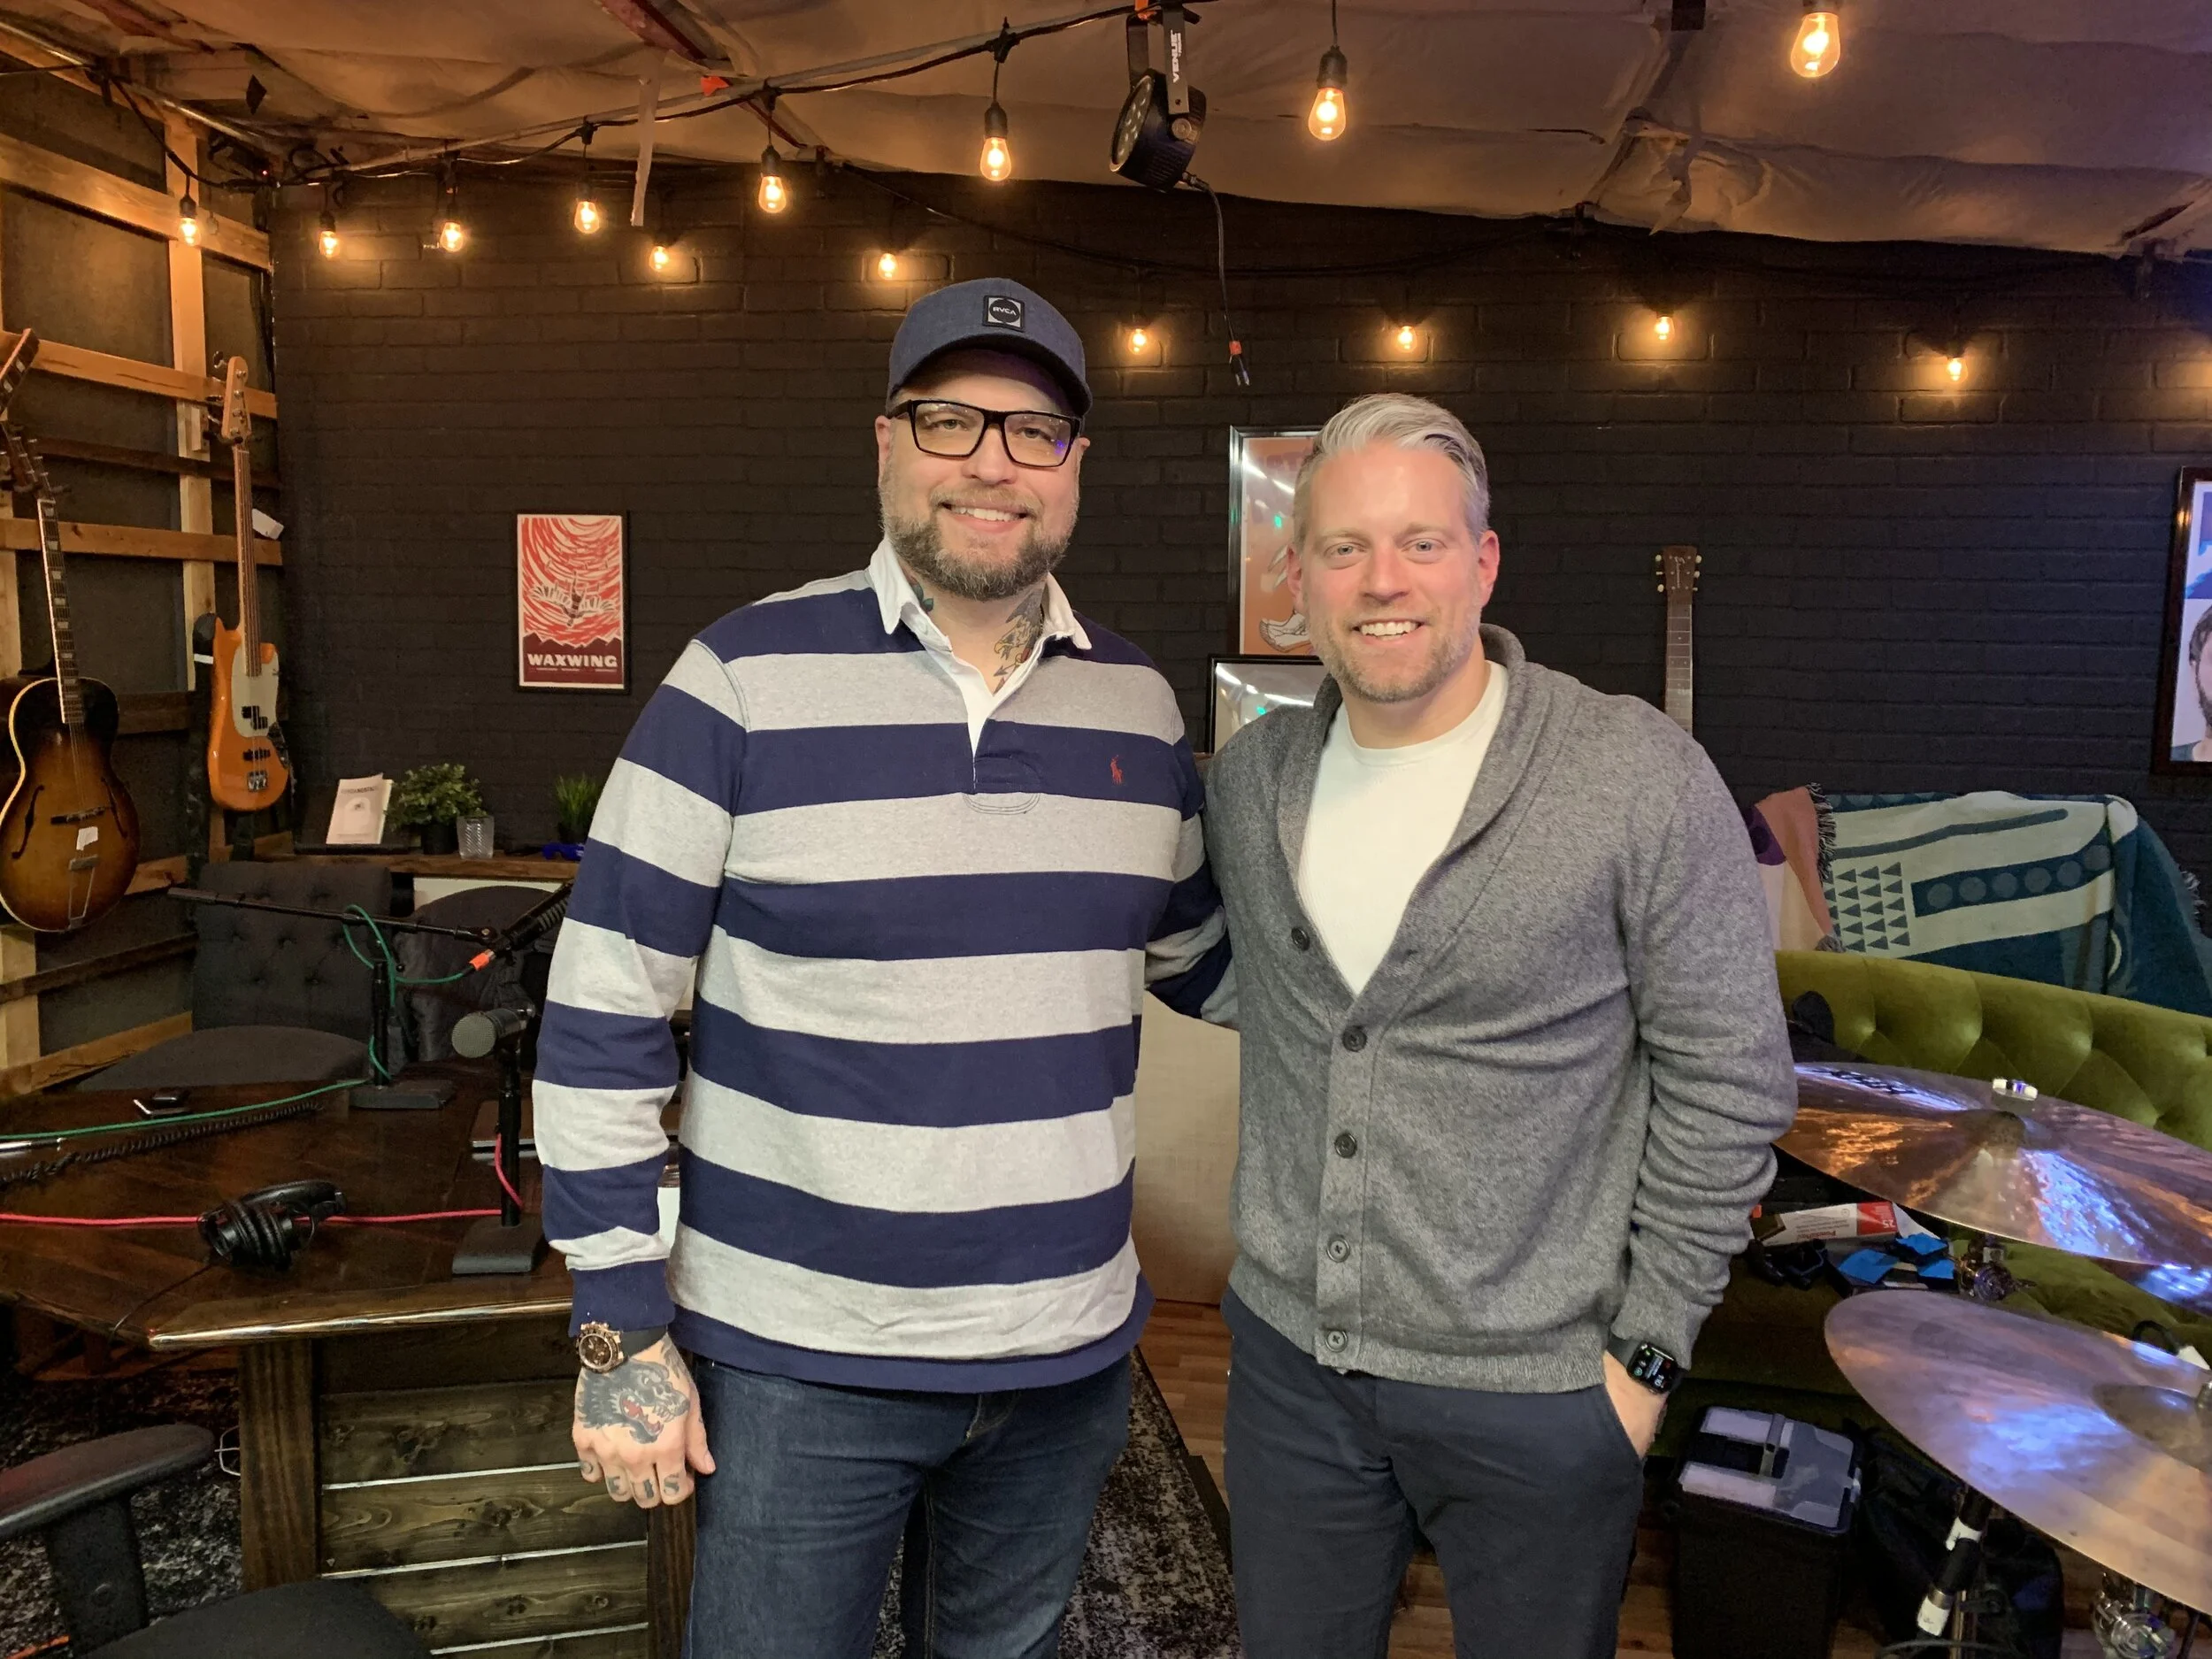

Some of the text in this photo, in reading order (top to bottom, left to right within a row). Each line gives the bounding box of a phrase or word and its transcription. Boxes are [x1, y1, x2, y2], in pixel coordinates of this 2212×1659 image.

[1170, 29, 1179, 83] VENUE
[993, 306, 1017, 316] RVCA
[527, 653, 618, 667] WAXWING
